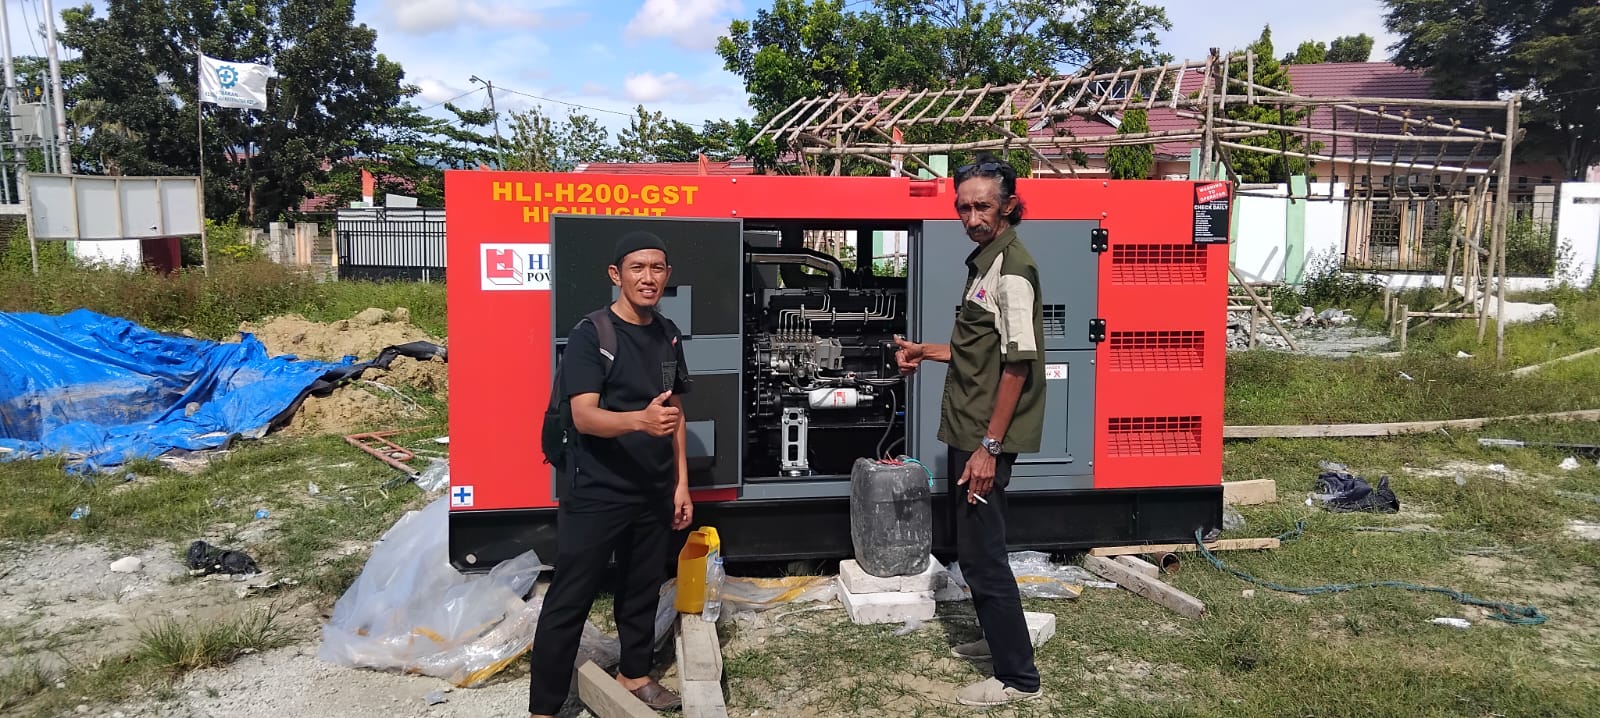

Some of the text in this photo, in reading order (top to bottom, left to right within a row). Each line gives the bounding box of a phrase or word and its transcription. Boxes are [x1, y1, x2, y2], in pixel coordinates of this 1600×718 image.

[1200, 183, 1222, 192] WARNING
[492, 181, 699, 204] HLI-H200-GST
[1200, 192, 1226, 201] OPERATOR
